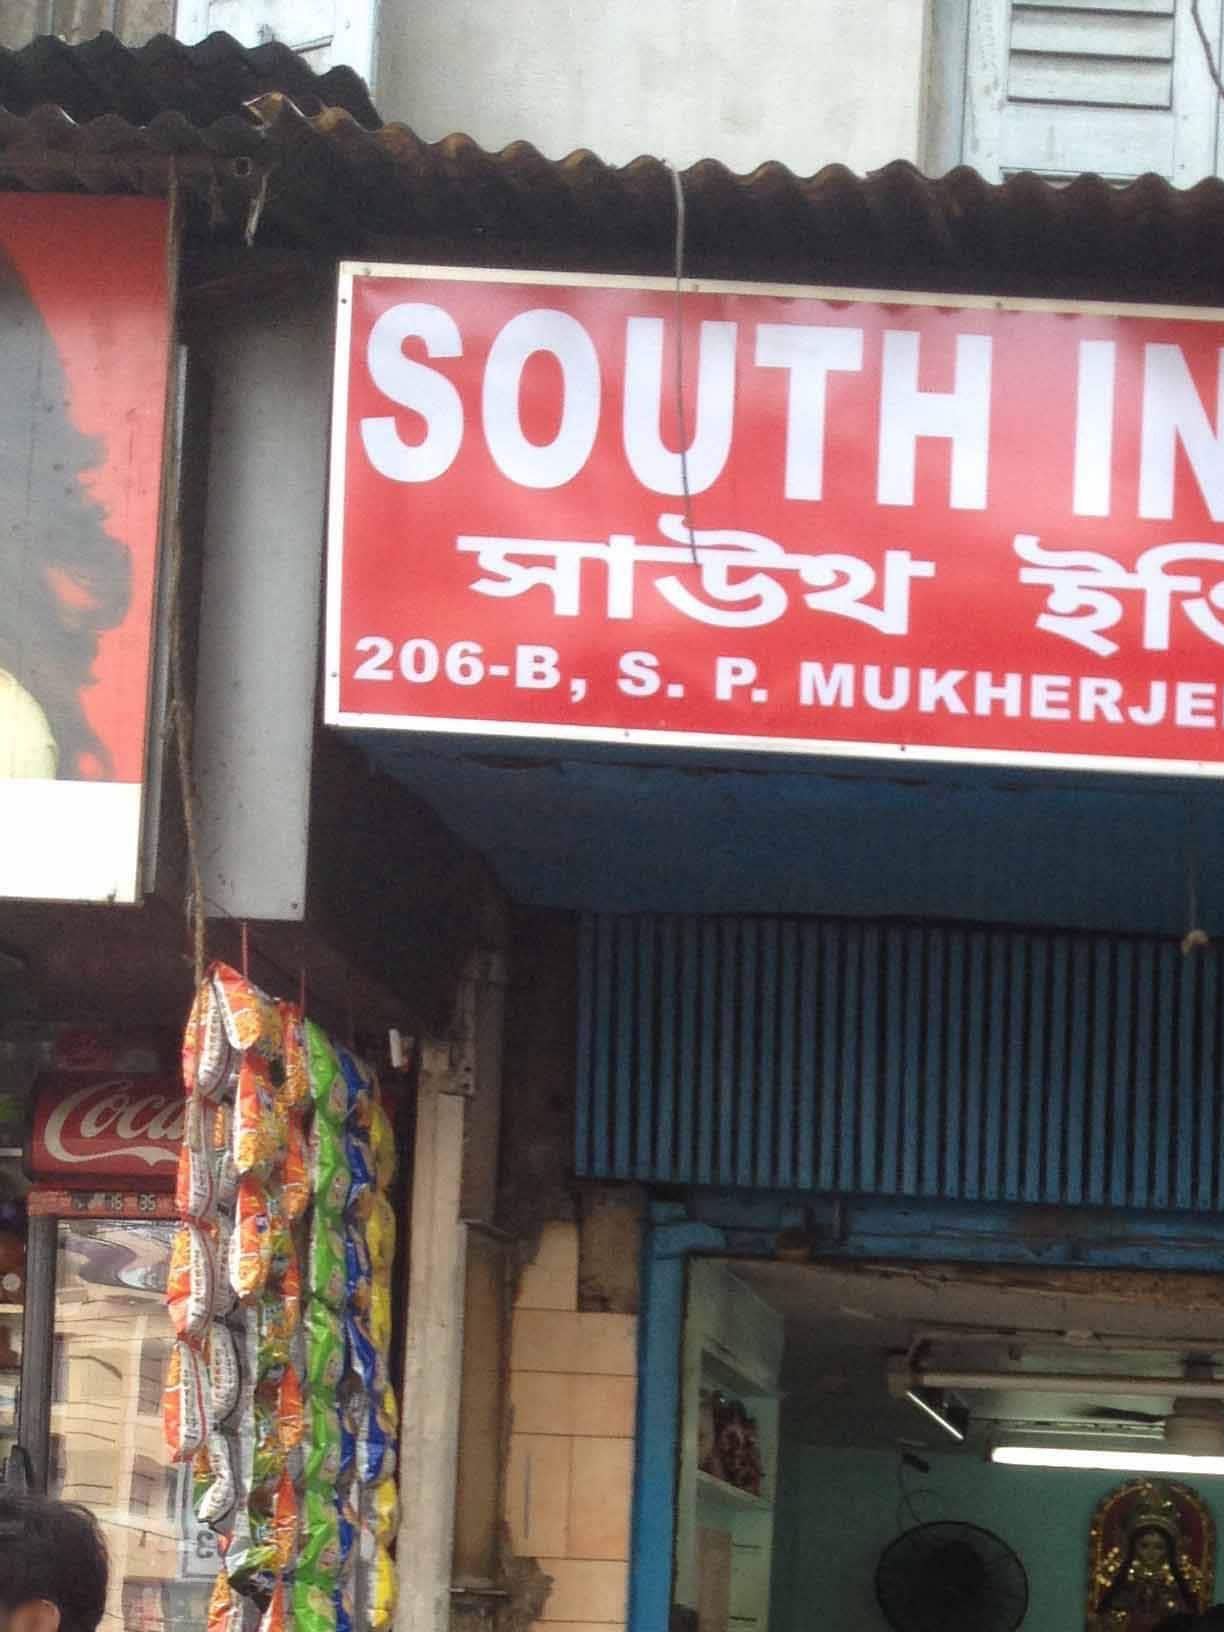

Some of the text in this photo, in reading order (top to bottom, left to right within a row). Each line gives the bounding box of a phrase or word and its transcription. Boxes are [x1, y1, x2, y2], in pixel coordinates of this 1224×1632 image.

[359, 302, 993, 511] SOUTH
[456, 513, 936, 635] সাউথ
[354, 636, 588, 704] 206-B,
[617, 651, 684, 698] S.
[716, 656, 768, 703] P.
